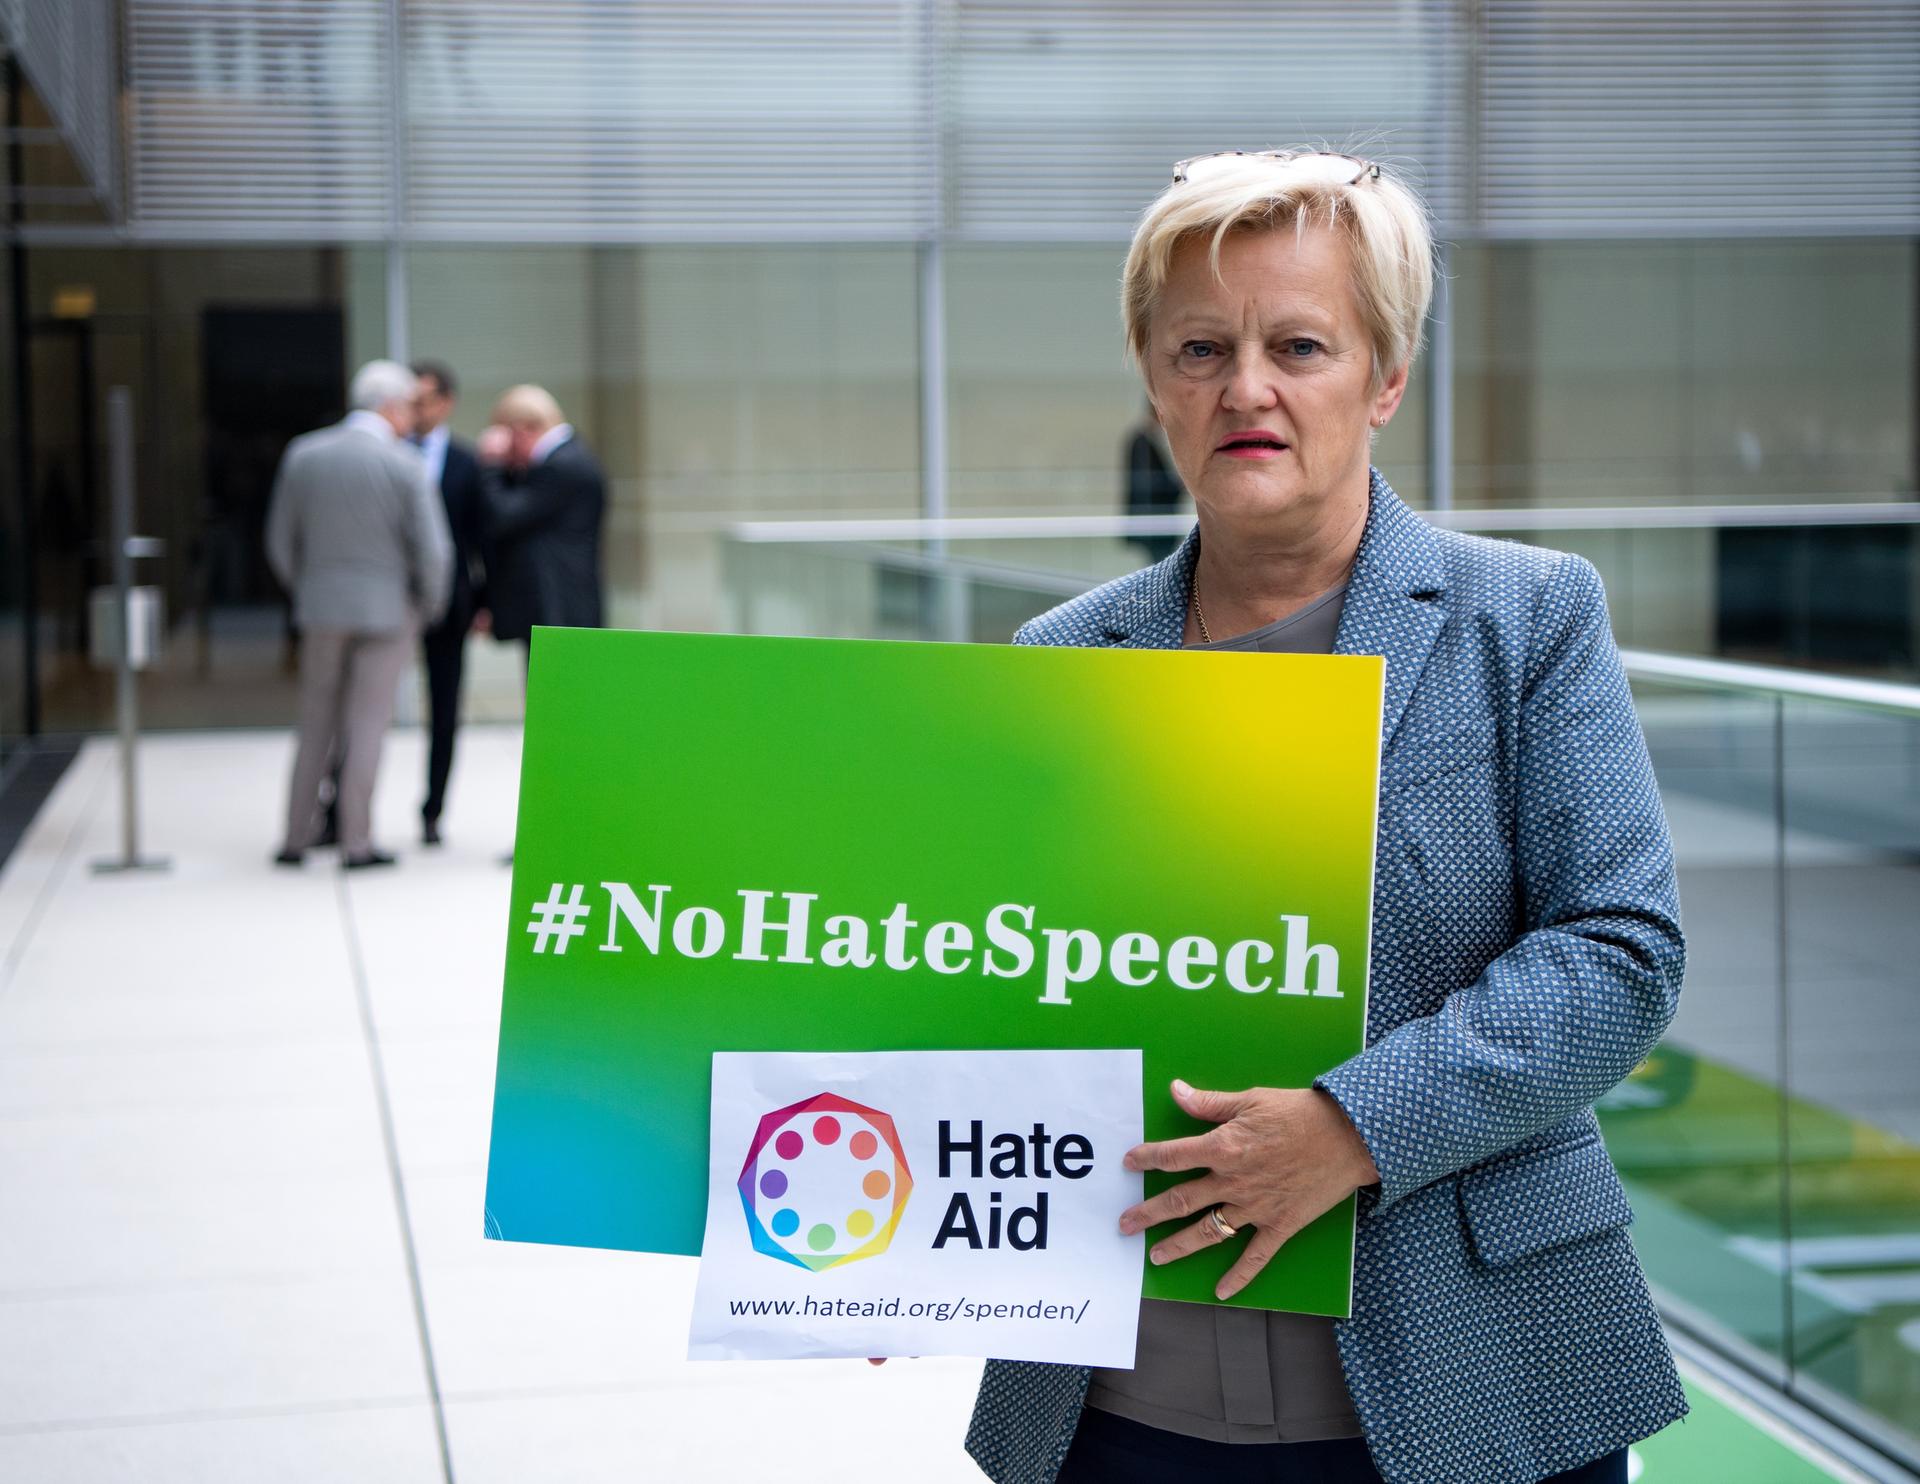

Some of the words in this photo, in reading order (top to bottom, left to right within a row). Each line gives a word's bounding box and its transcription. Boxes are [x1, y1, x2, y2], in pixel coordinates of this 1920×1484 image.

[526, 881, 1344, 1005] #NoHateSpeech
[938, 1119, 1095, 1180] Hate
[931, 1192, 1049, 1251] Aid
[729, 1295, 1090, 1324] www.hateaid.org/spenden/
